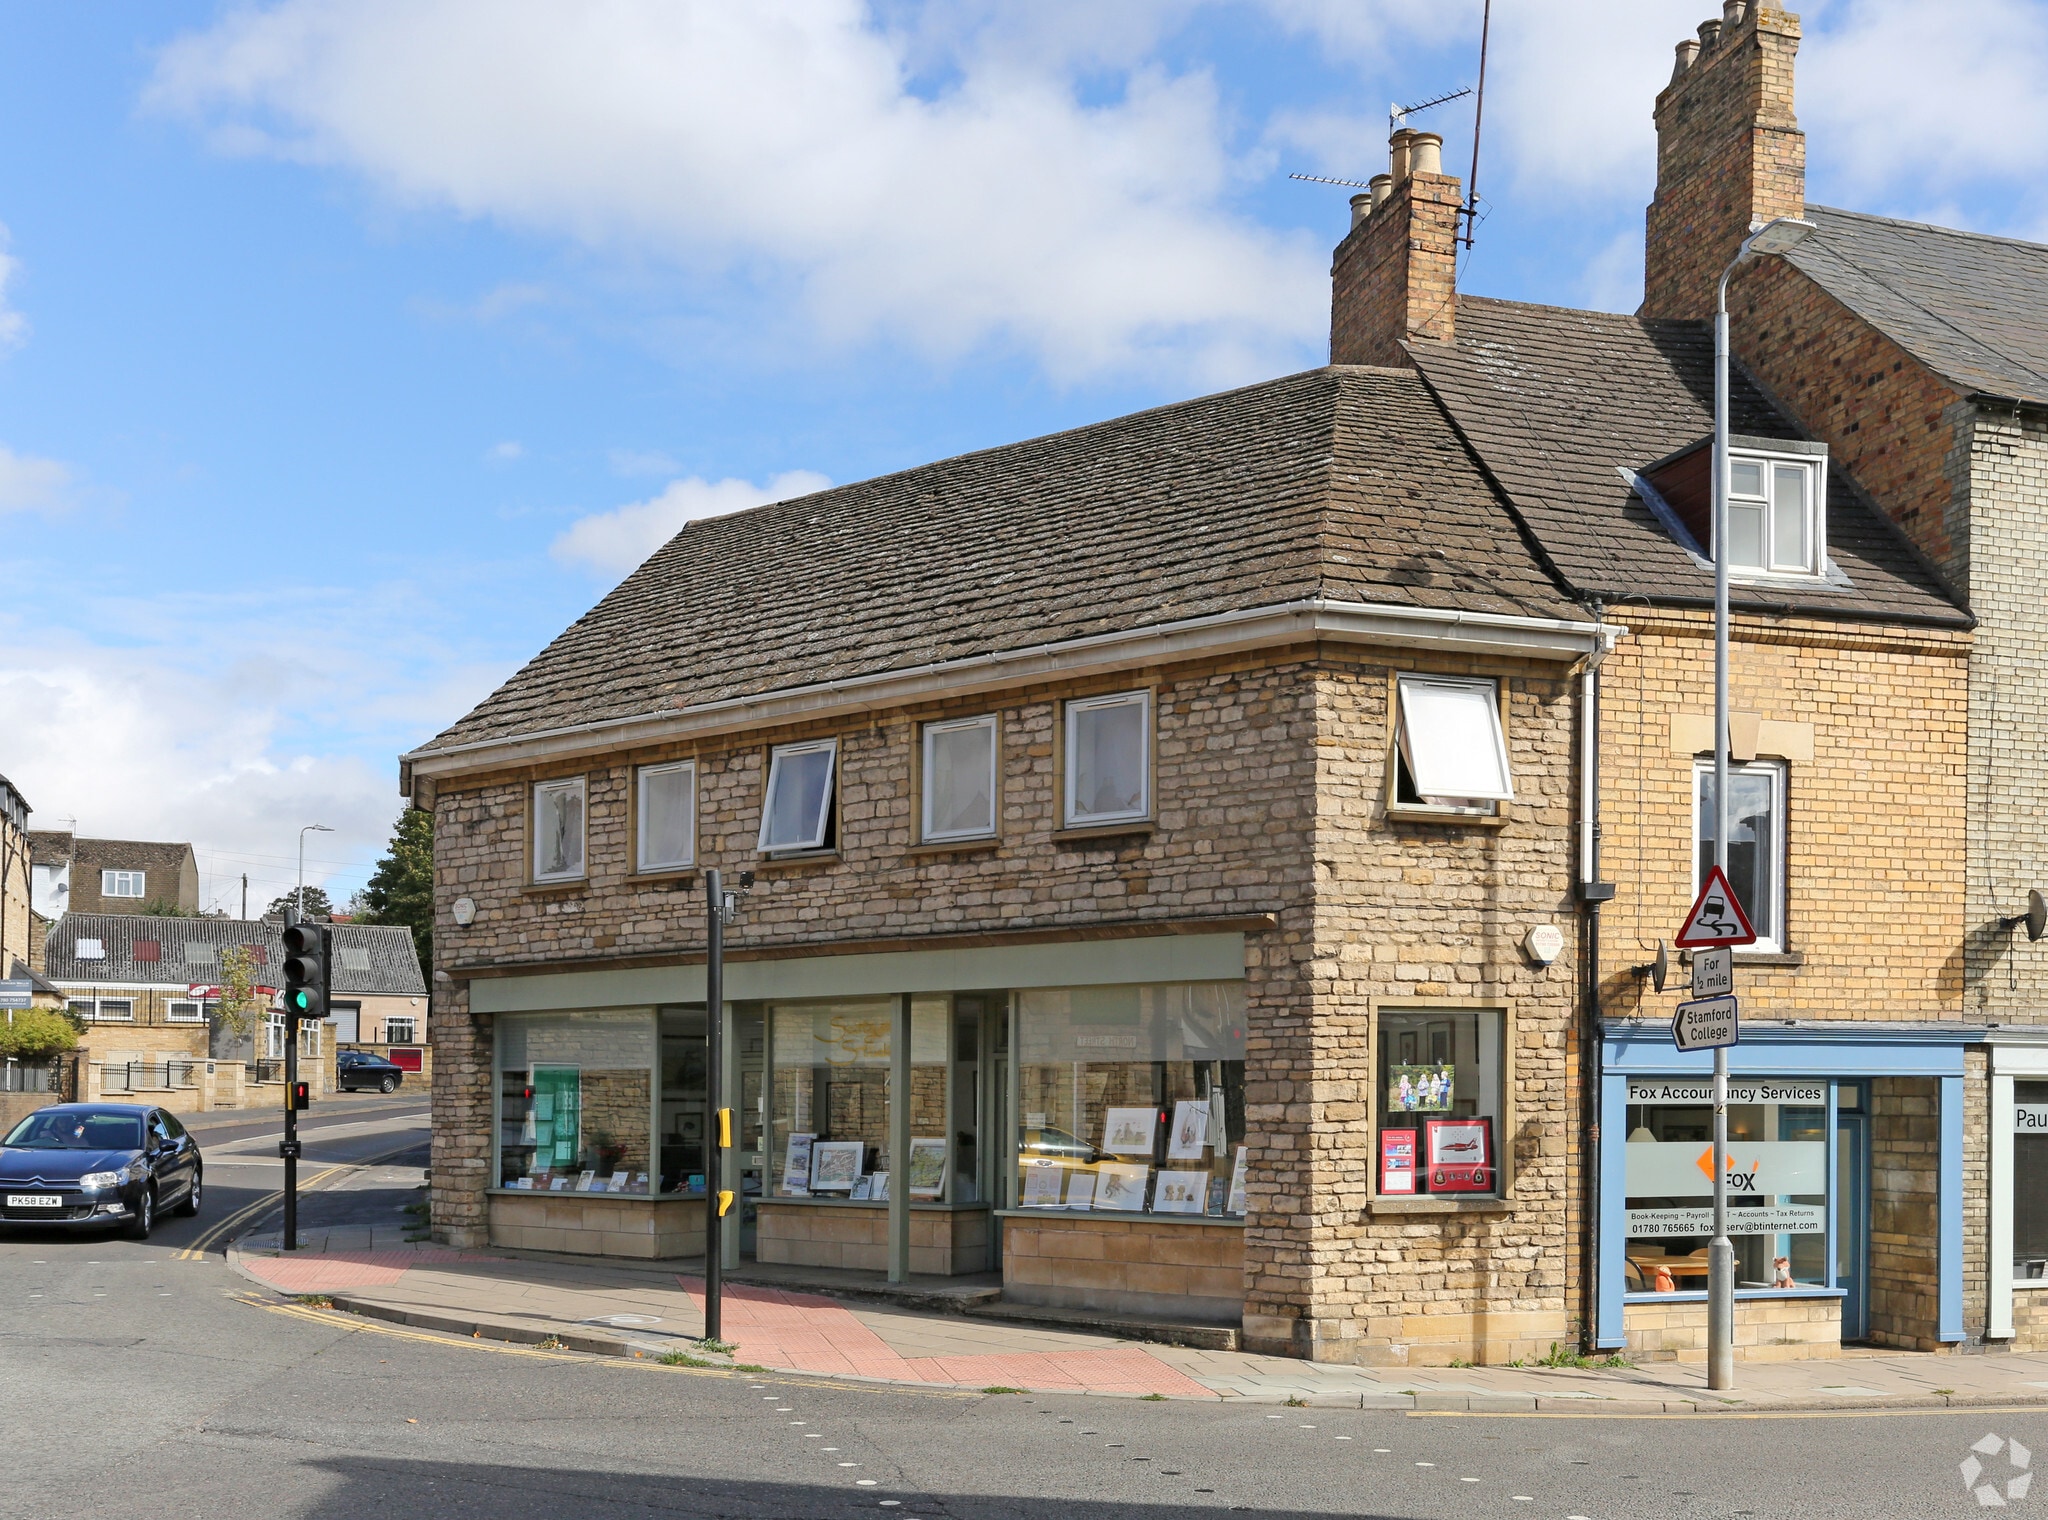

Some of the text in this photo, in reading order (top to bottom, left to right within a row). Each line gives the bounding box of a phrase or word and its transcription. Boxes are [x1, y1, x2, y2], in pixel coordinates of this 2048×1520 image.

[1535, 931, 1560, 940] SONIC
[1704, 958, 1719, 971] For
[1707, 973, 1728, 987] mile
[1687, 1006, 1732, 1025] Stamford
[1691, 1027, 1728, 1041] College
[1630, 1086, 1657, 1099] Fox
[1760, 1086, 1821, 1100] Services
[2016, 1109, 2048, 1128] Pau
[11, 1196, 58, 1206] PK58 EZW
[1631, 1212, 1679, 1220] Book-Keeping
[1686, 1211, 1709, 1220] Payroll
[1632, 1224, 1660, 1233] 01780
[1662, 1223, 1695, 1233] 765665
